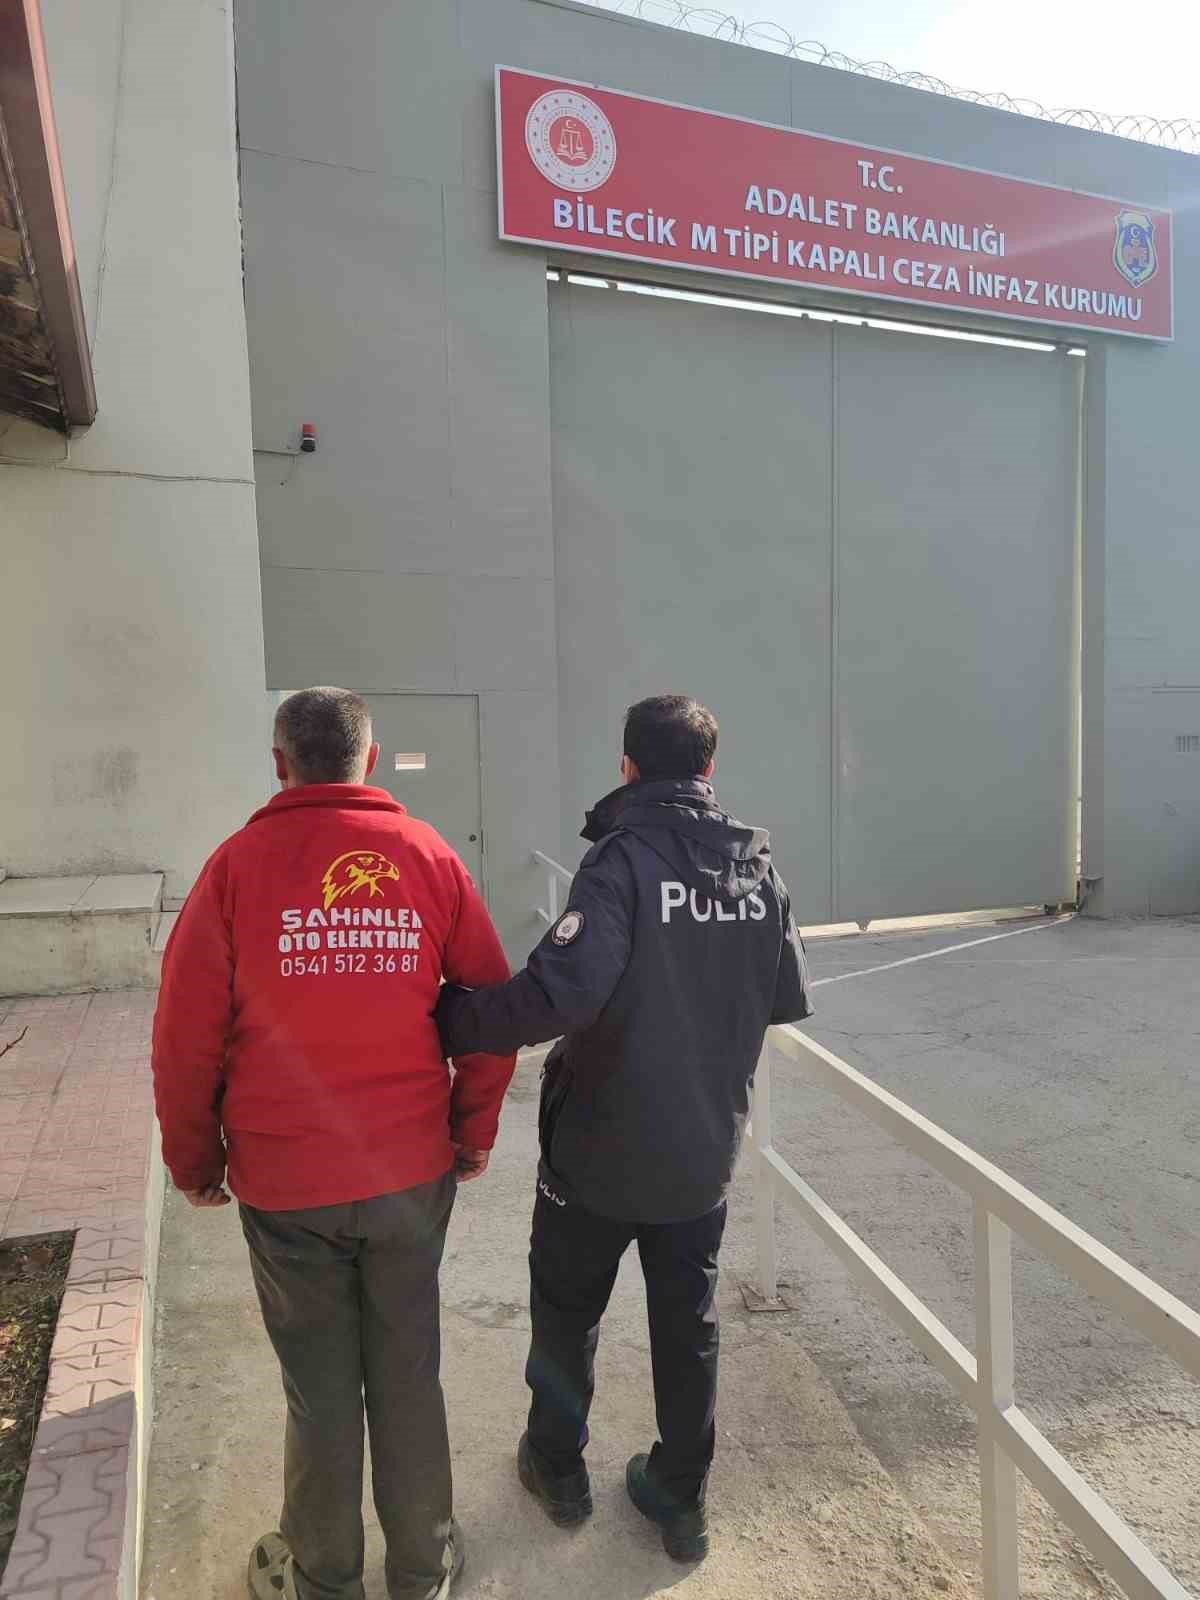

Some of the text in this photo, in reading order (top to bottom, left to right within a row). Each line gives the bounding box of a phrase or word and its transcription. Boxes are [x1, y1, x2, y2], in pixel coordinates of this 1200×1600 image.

[857, 159, 904, 194] T.C.
[744, 184, 1006, 257] ADALET BAKANLIĞI
[552, 196, 1143, 321] BİLECİK M TİPİ KAPALI CEZA İNFAZ KURUMU
[278, 928, 421, 953] OTO ELEKTRİK
[280, 953, 419, 977] 0541 512 36 81
